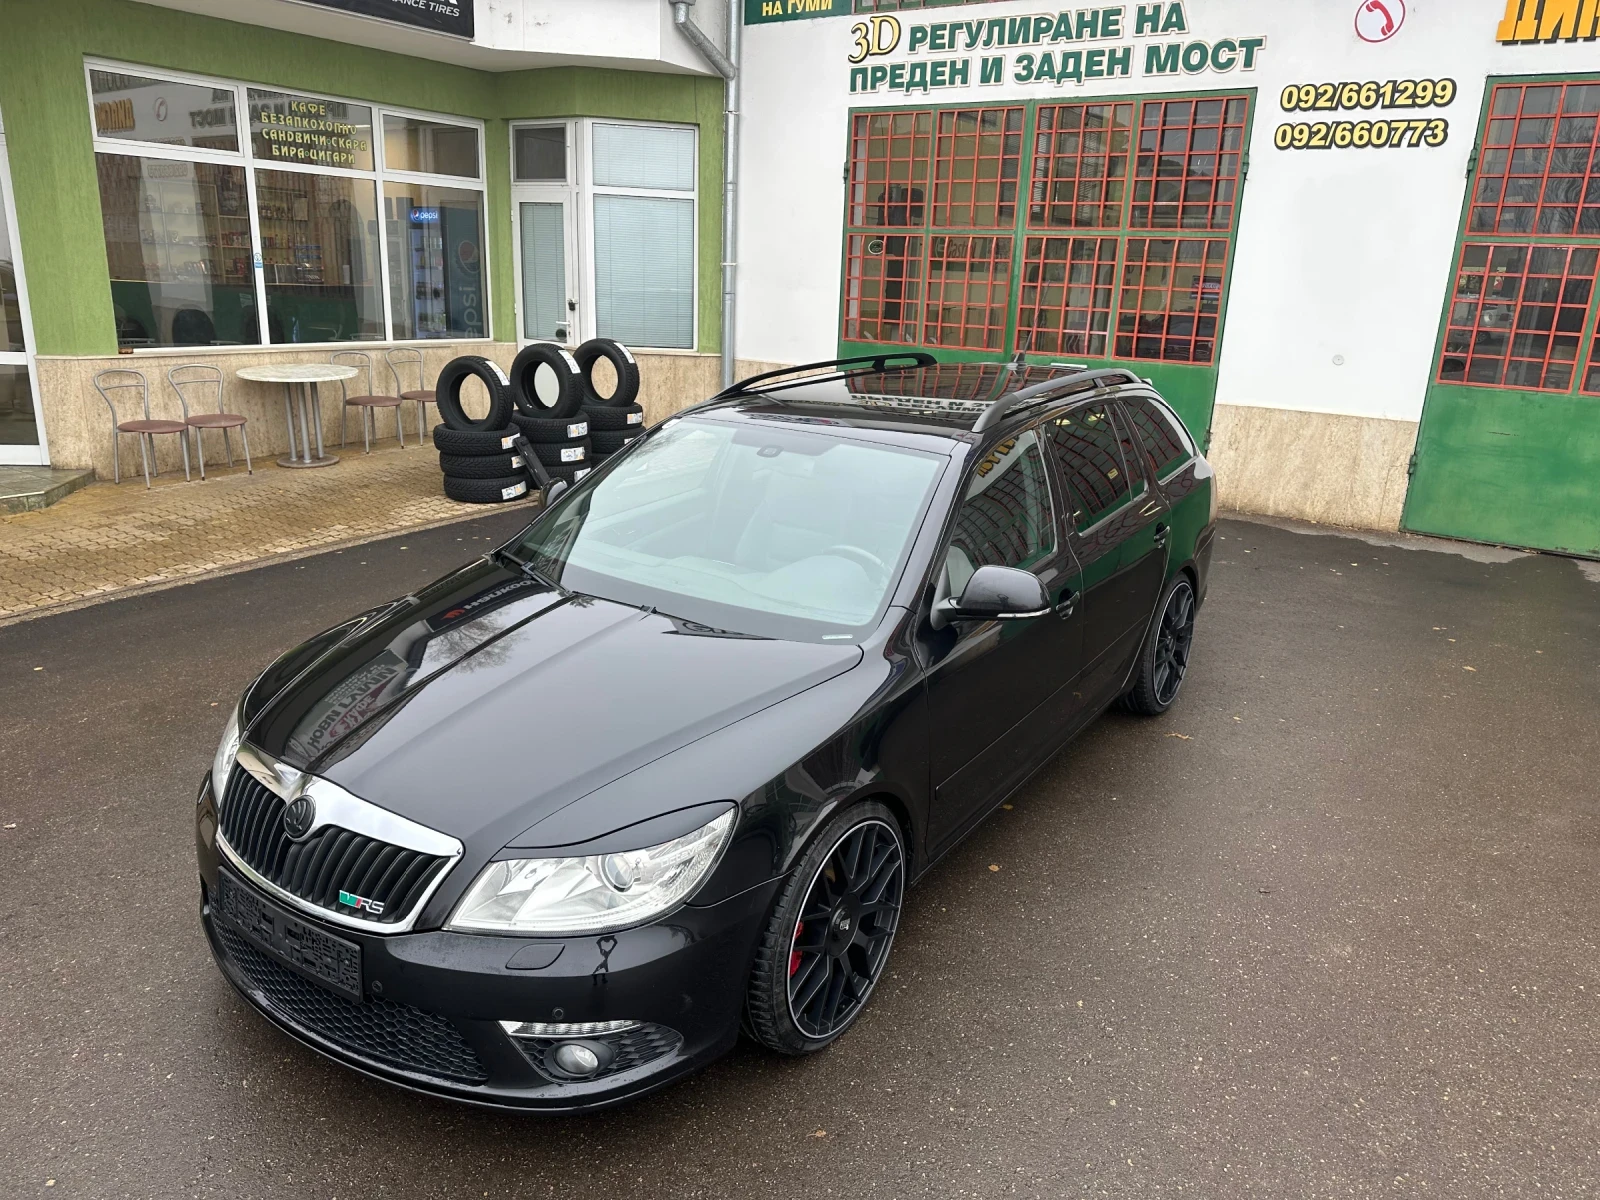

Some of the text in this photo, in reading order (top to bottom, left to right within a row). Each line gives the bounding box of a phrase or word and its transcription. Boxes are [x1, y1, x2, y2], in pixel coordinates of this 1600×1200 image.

[429, 2, 460, 17] TIRES
[762, 0, 833, 16] НА ГУМИ
[848, 2, 1188, 63] 3D РЕГУЛИРАНЕ НА
[849, 37, 1264, 93] ПРЕДЕН И ЗАДЕН МОСТ
[1280, 78, 1457, 112] 092/661299
[291, 100, 326, 116] КАФЕ
[331, 137, 367, 151] СКАРА
[1274, 118, 1449, 150] 092/660773
[272, 144, 355, 164] БИРА ЦИГАРИ
[420, 210, 438, 221] pepsi
[459, 285, 482, 338] epsi
